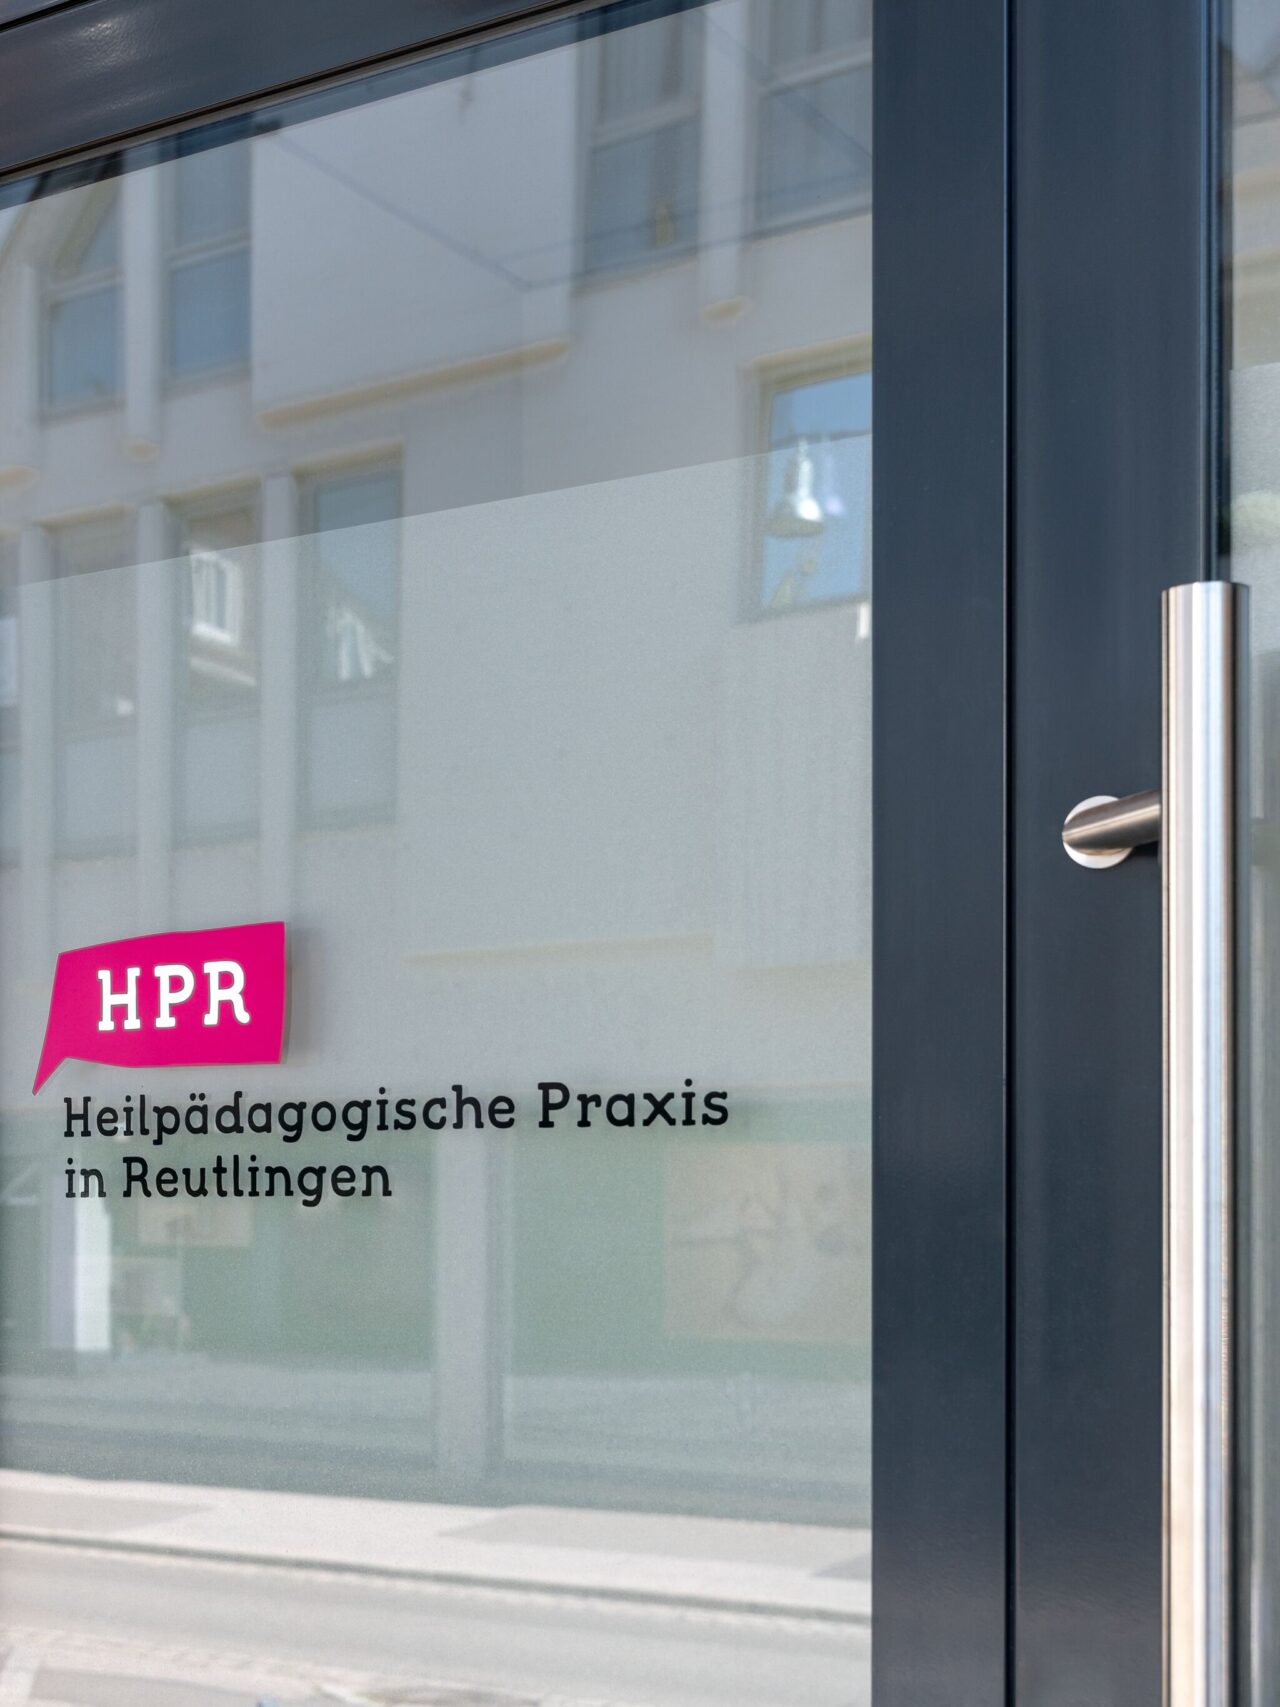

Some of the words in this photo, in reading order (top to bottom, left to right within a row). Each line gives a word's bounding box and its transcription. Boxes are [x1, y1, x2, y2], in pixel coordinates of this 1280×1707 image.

[97, 960, 251, 1032] HPR
[63, 1084, 516, 1146] Heilpädagogische
[536, 1078, 730, 1129] Praxis
[64, 1157, 107, 1199] in
[121, 1154, 393, 1208] Reutlingen
